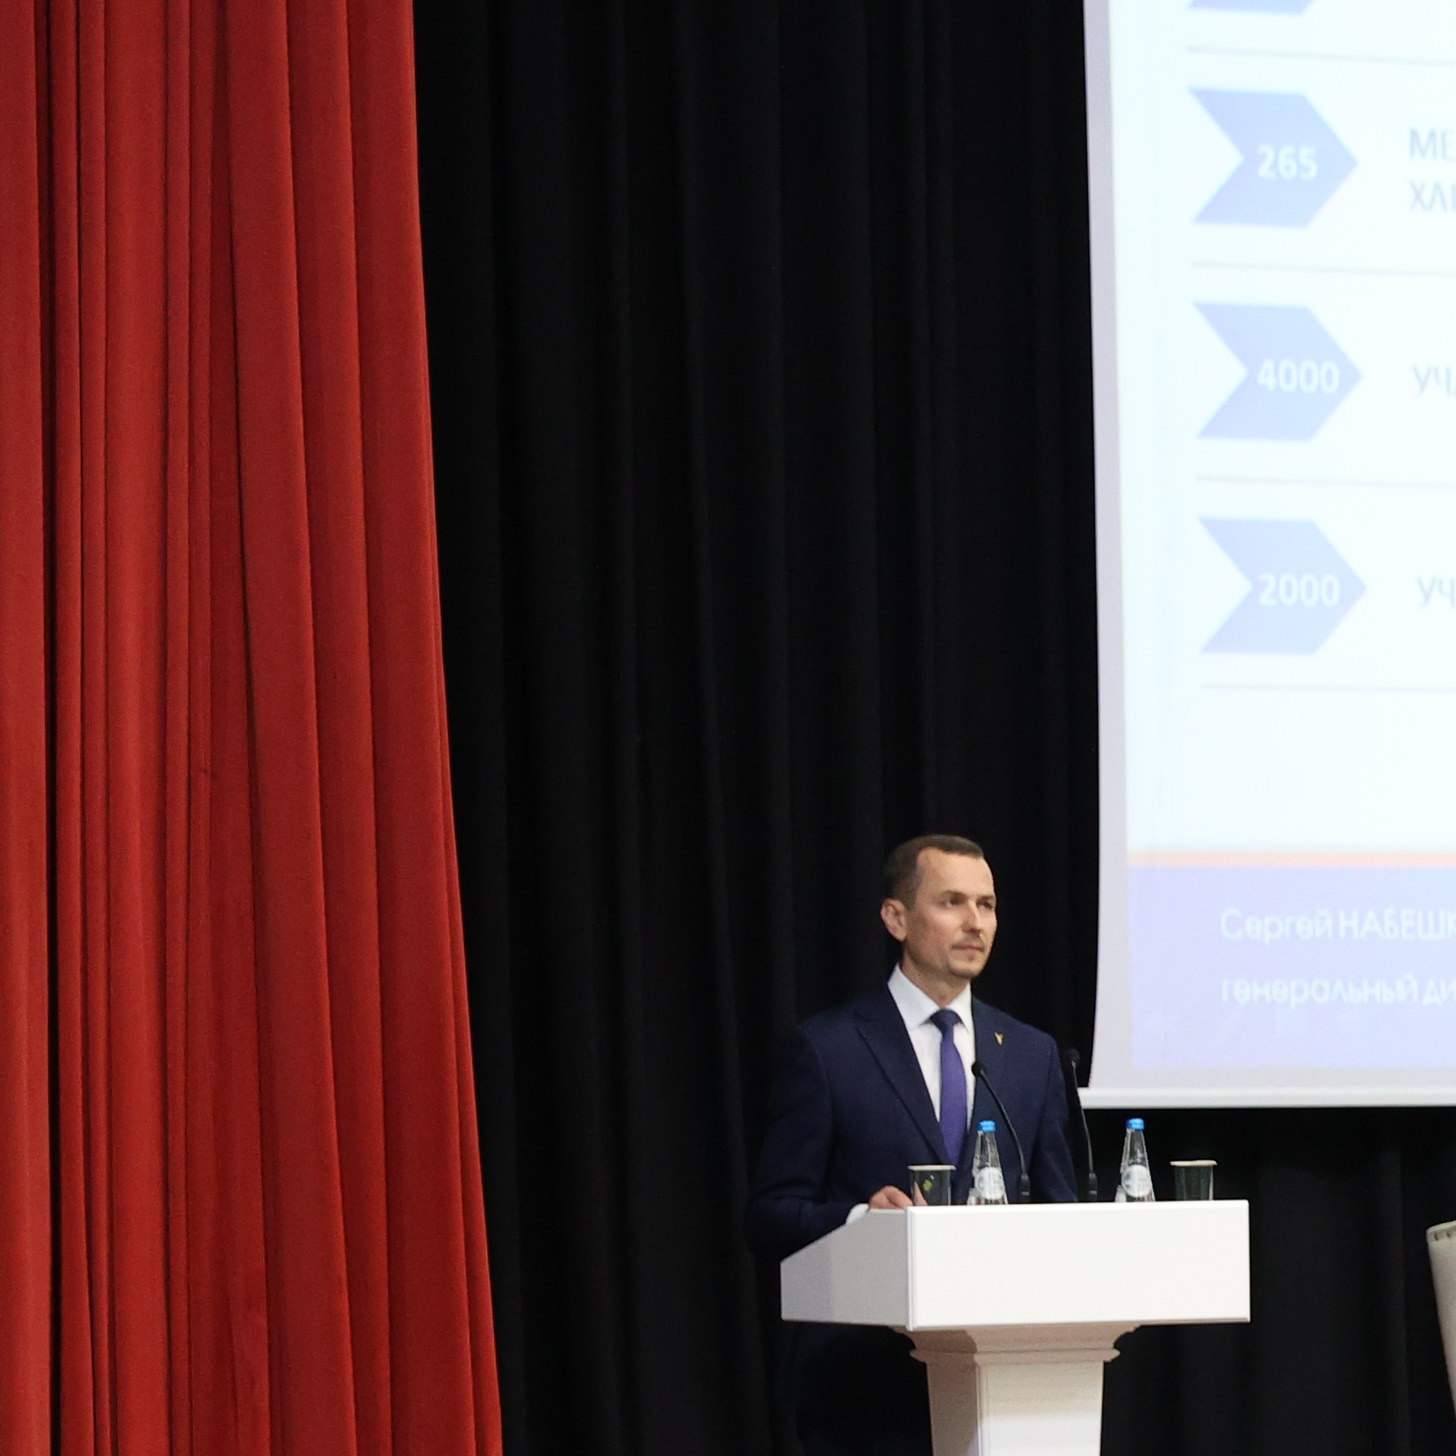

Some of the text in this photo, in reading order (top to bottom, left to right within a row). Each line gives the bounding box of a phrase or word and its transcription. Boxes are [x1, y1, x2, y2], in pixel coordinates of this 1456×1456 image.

[1256, 146, 1319, 181] 265
[1256, 361, 1340, 396] 4000
[1258, 573, 1340, 608] 2000
[1220, 906, 1334, 943] Сергей
[1221, 972, 1418, 1007] генеральный
